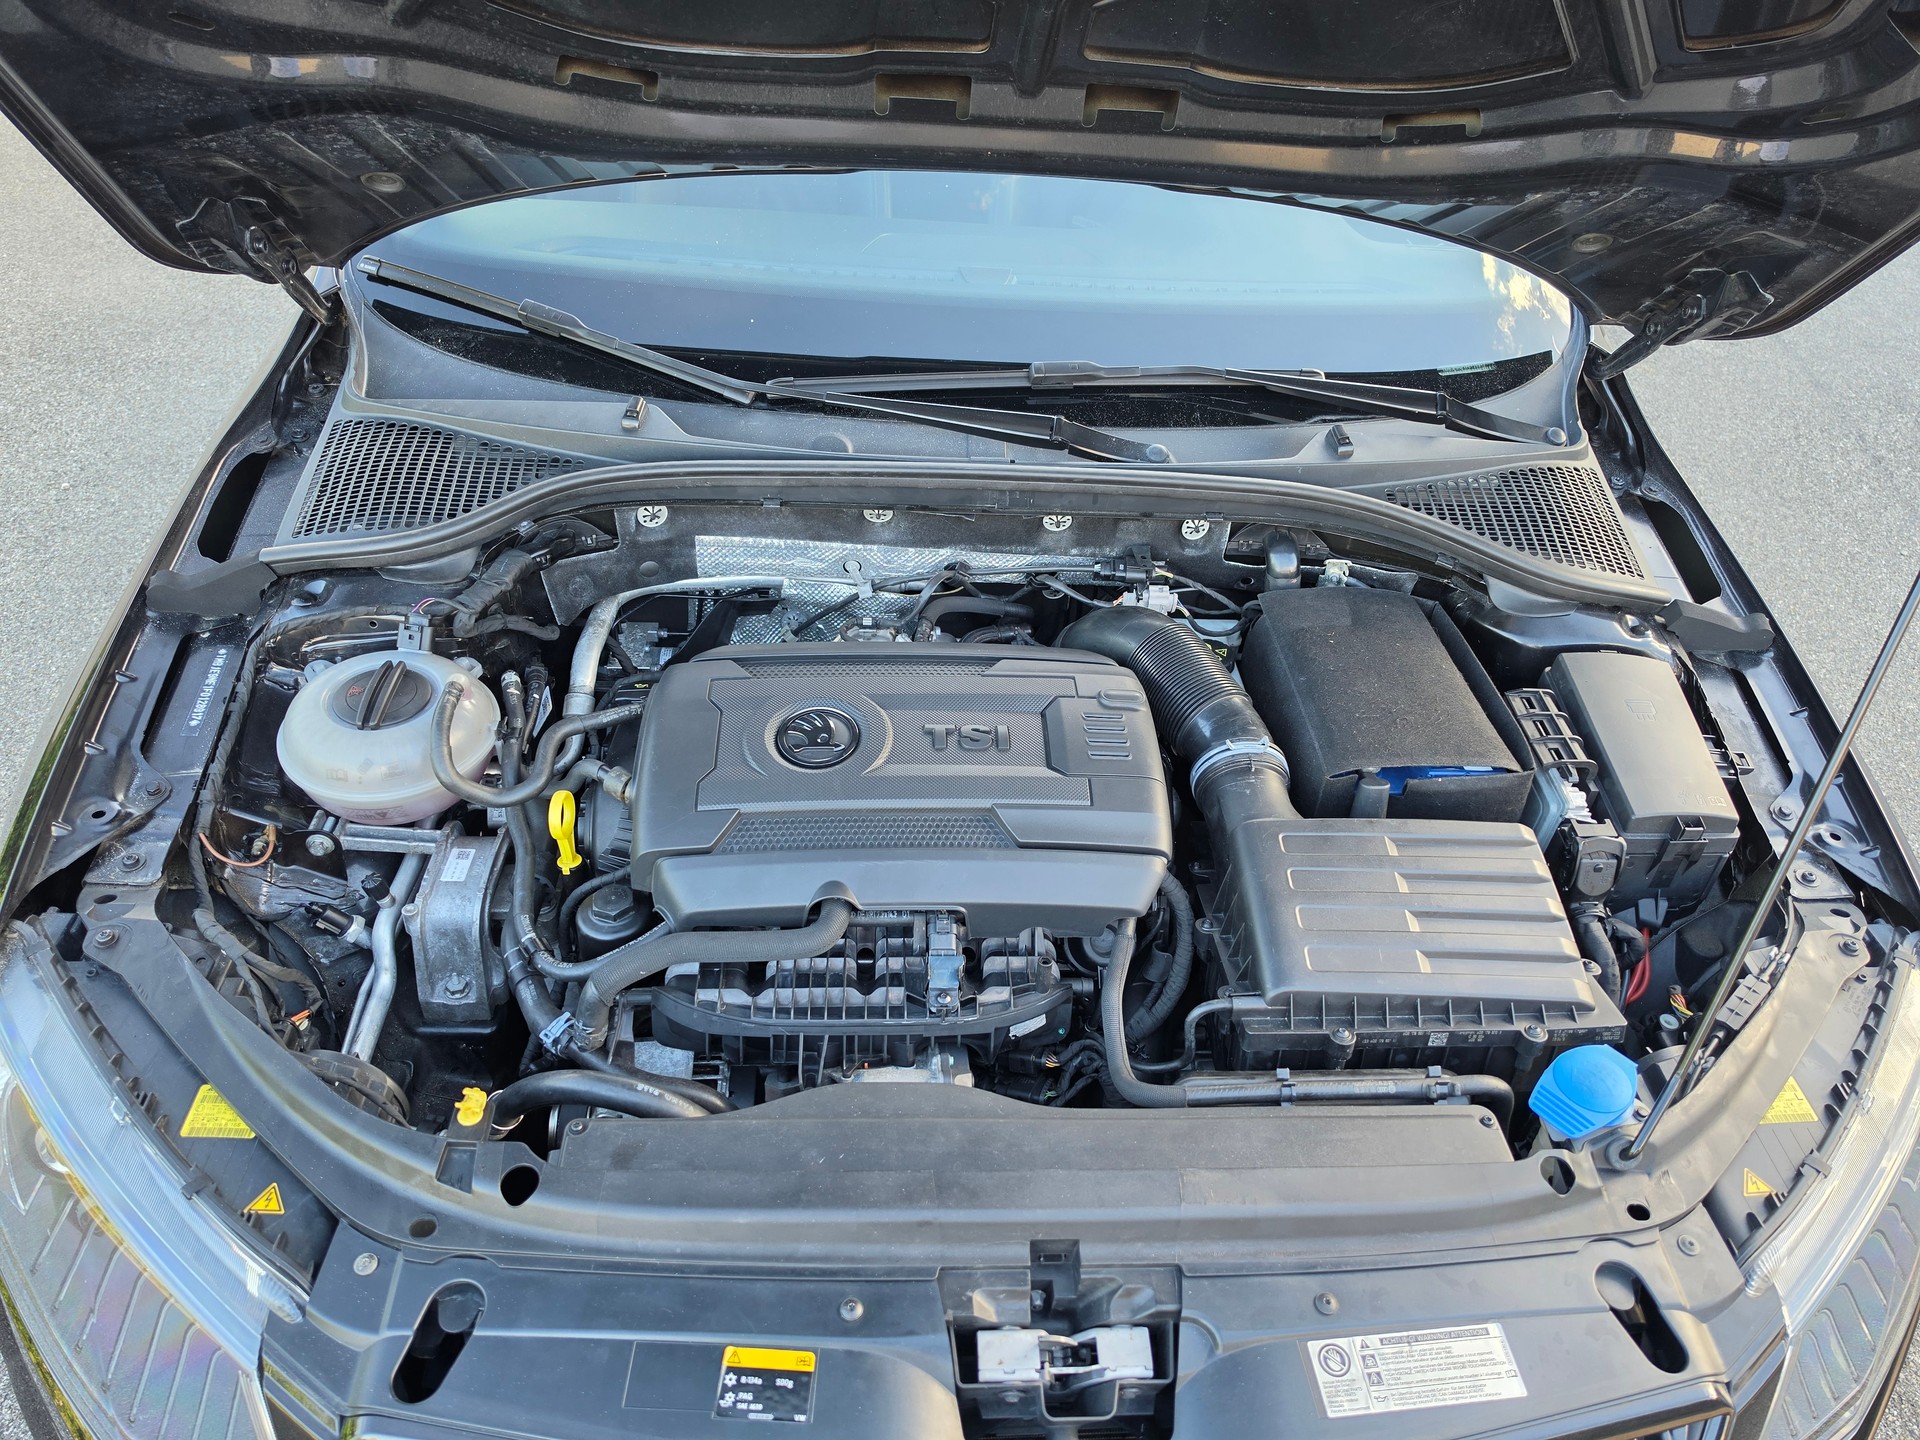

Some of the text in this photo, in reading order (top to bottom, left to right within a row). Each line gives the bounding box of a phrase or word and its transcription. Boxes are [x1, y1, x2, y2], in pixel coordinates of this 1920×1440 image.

[922, 724, 1010, 751] TSI
[1415, 1331, 1450, 1341] WARNING!
[1449, 1327, 1488, 1337] ATTENTION!
[793, 1414, 807, 1422] VW
